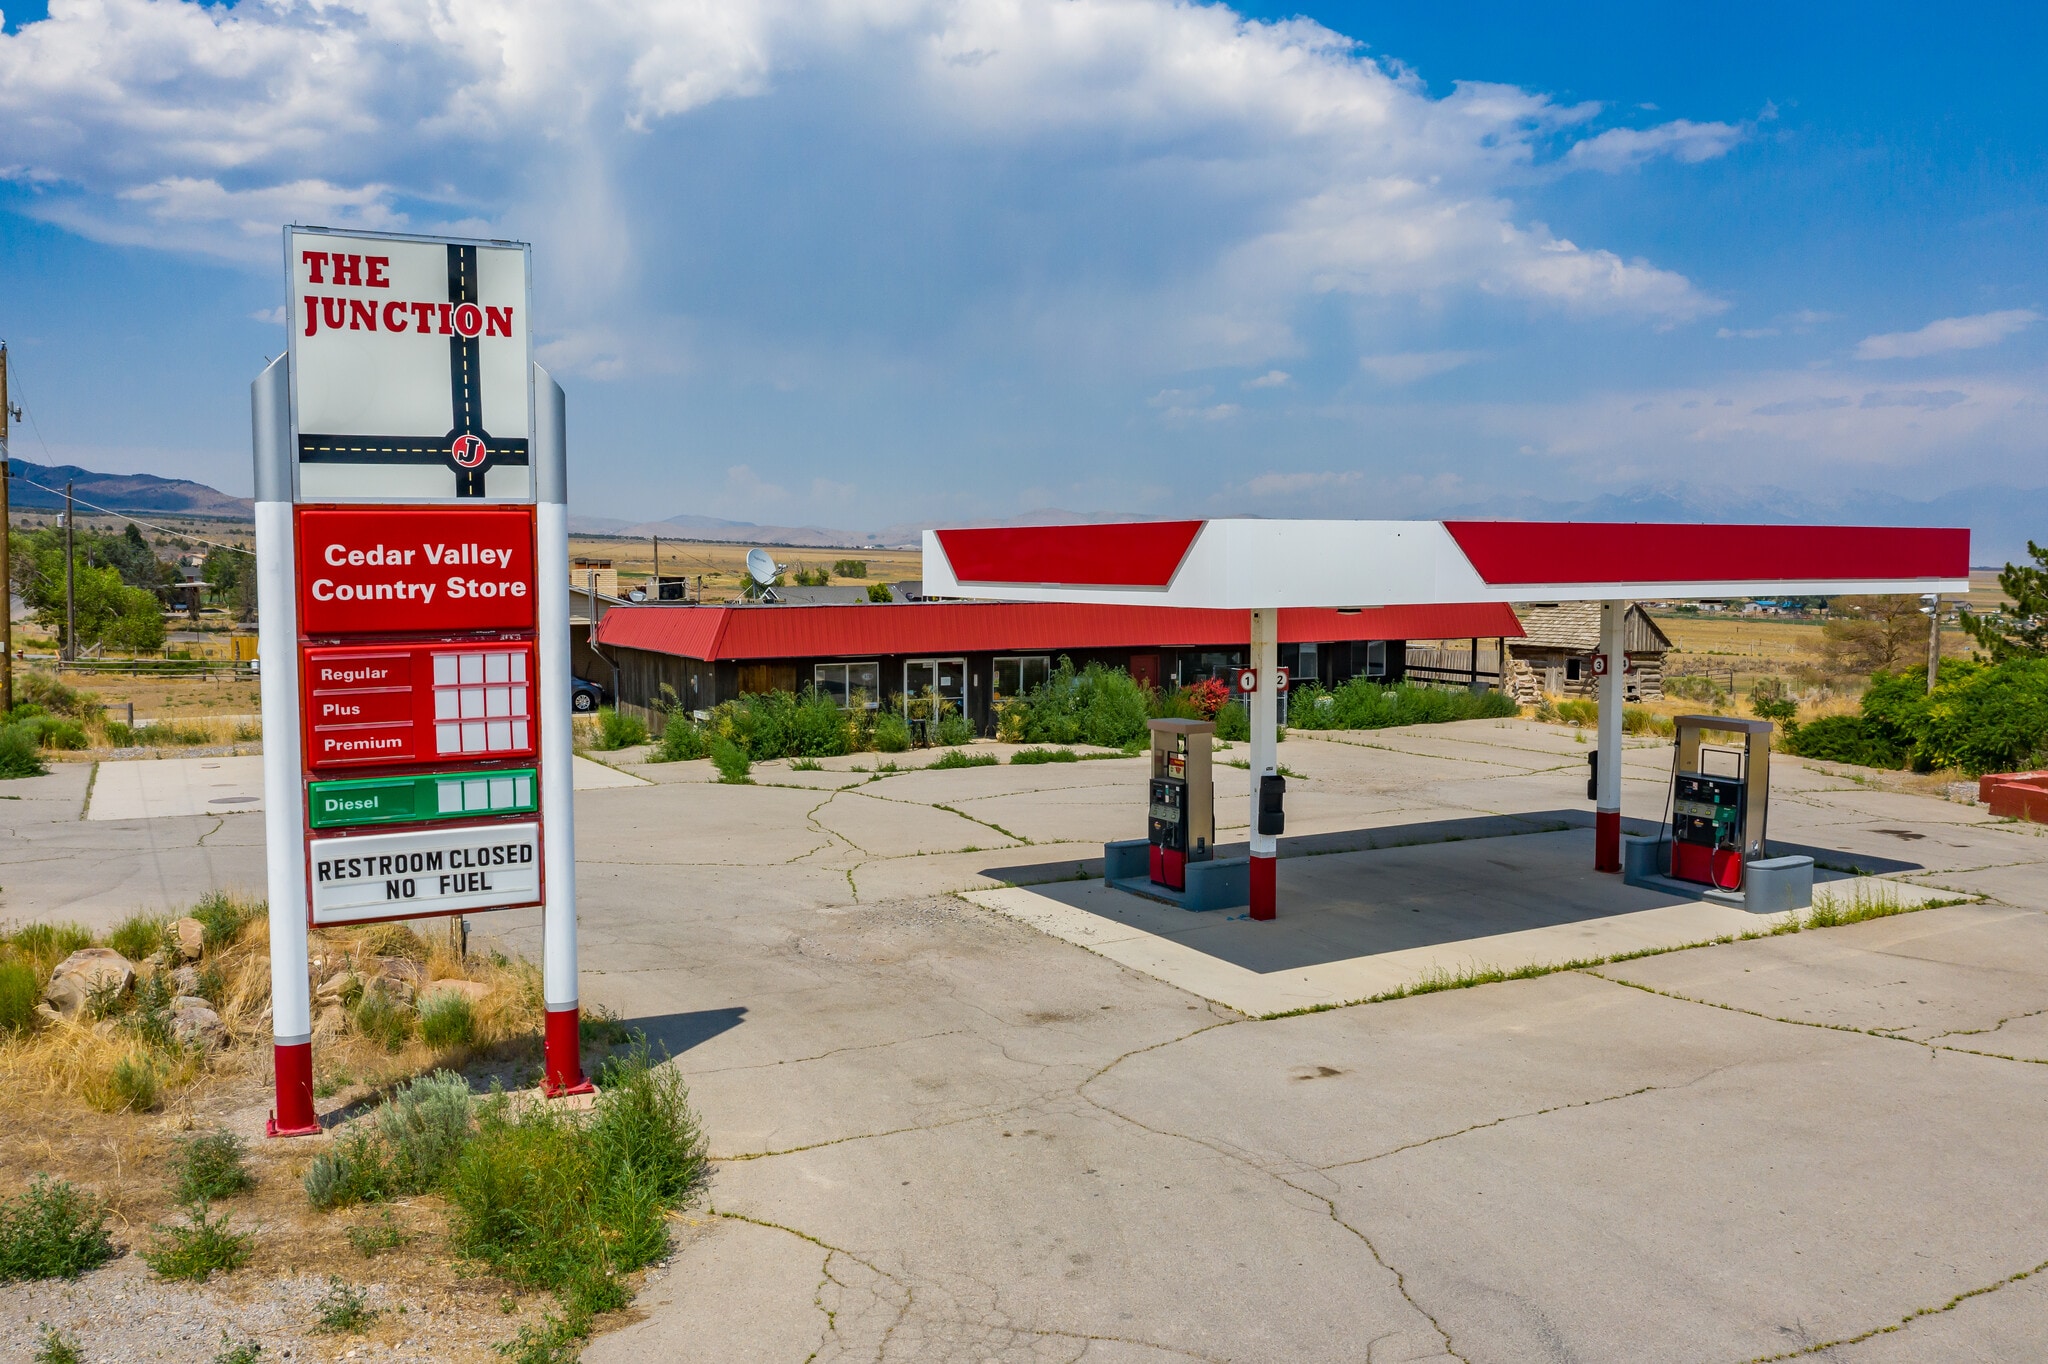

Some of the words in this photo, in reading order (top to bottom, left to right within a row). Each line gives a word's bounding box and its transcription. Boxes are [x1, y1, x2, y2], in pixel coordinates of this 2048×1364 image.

[302, 250, 390, 288] THE
[304, 295, 513, 338] JUNCTION
[458, 438, 481, 463] J
[324, 543, 416, 567] Cedar
[423, 543, 513, 569] Valley
[311, 578, 437, 603] Country
[446, 576, 527, 599] Store
[320, 666, 389, 683] Regular
[1276, 675, 1284, 685] 2
[322, 703, 361, 717] Plus
[324, 737, 403, 752] Premium
[325, 795, 379, 812] Diesel
[317, 850, 443, 882] RESTROOM
[449, 843, 533, 869] CLOSED
[386, 878, 416, 900] NO
[439, 871, 493, 895] FUEL
